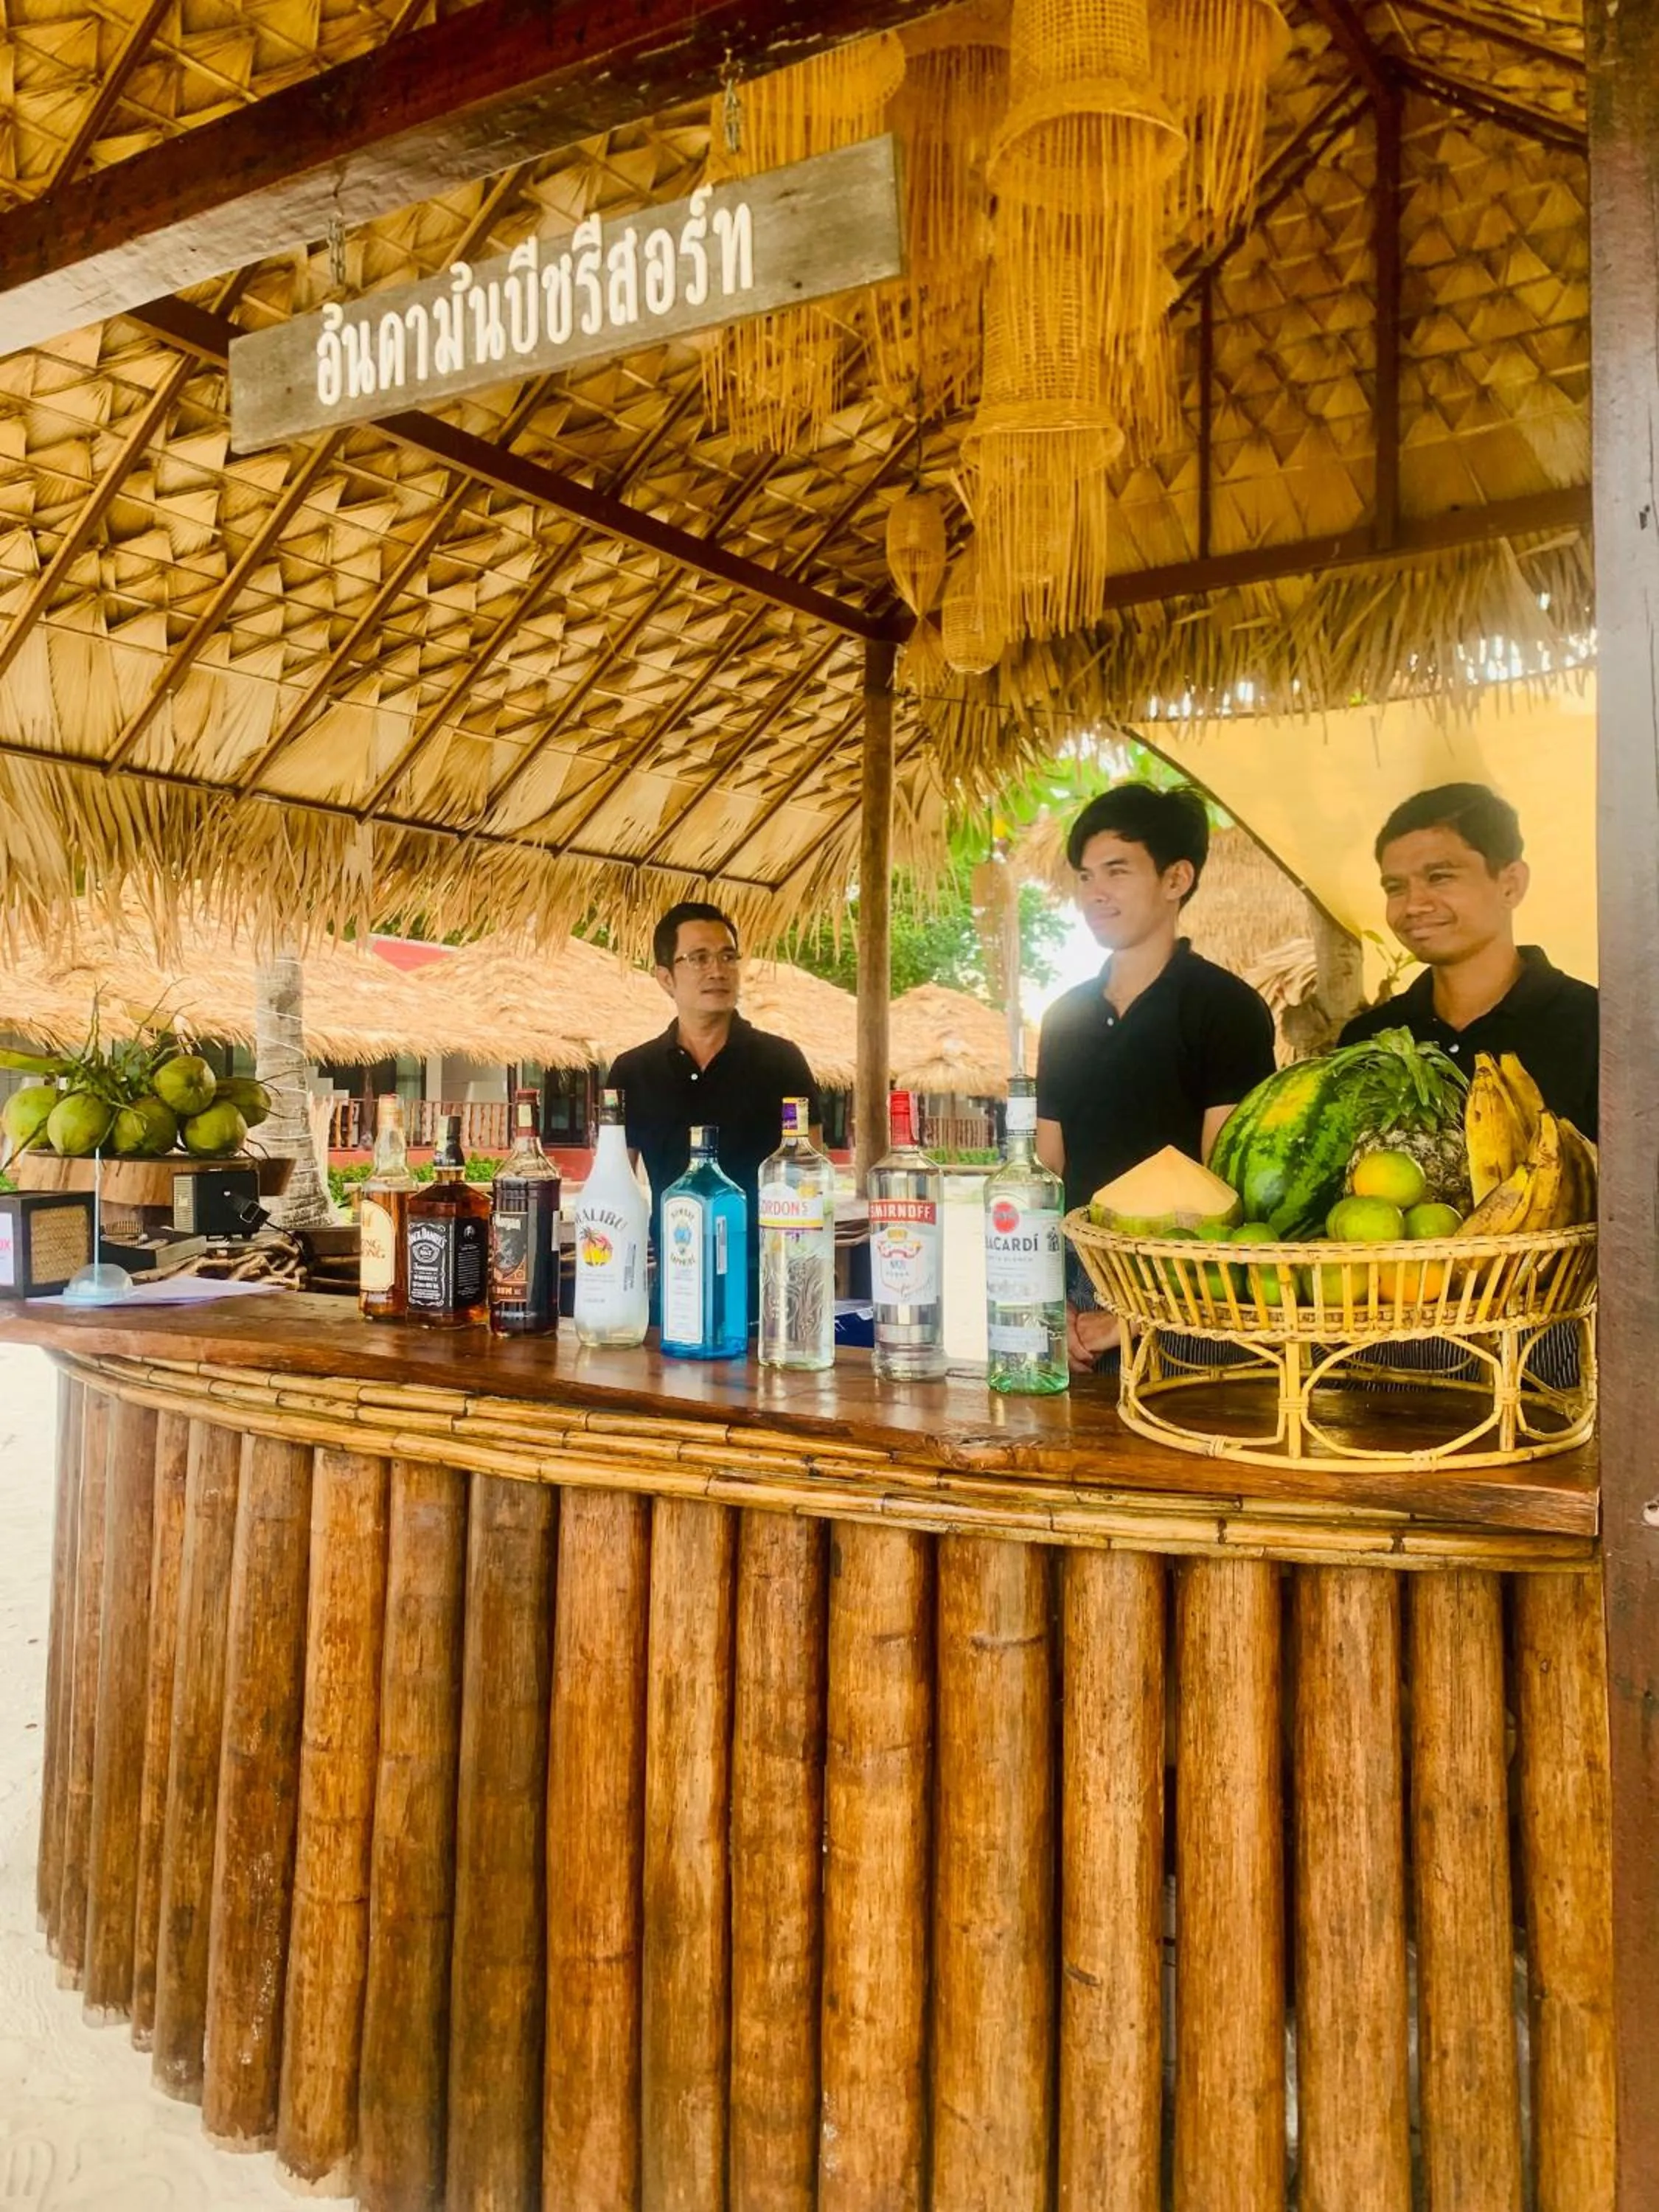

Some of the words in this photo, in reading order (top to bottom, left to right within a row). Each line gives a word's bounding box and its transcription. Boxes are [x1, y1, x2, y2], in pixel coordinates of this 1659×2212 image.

[317, 182, 753, 406] อันดามันบีชรีสอร์ท
